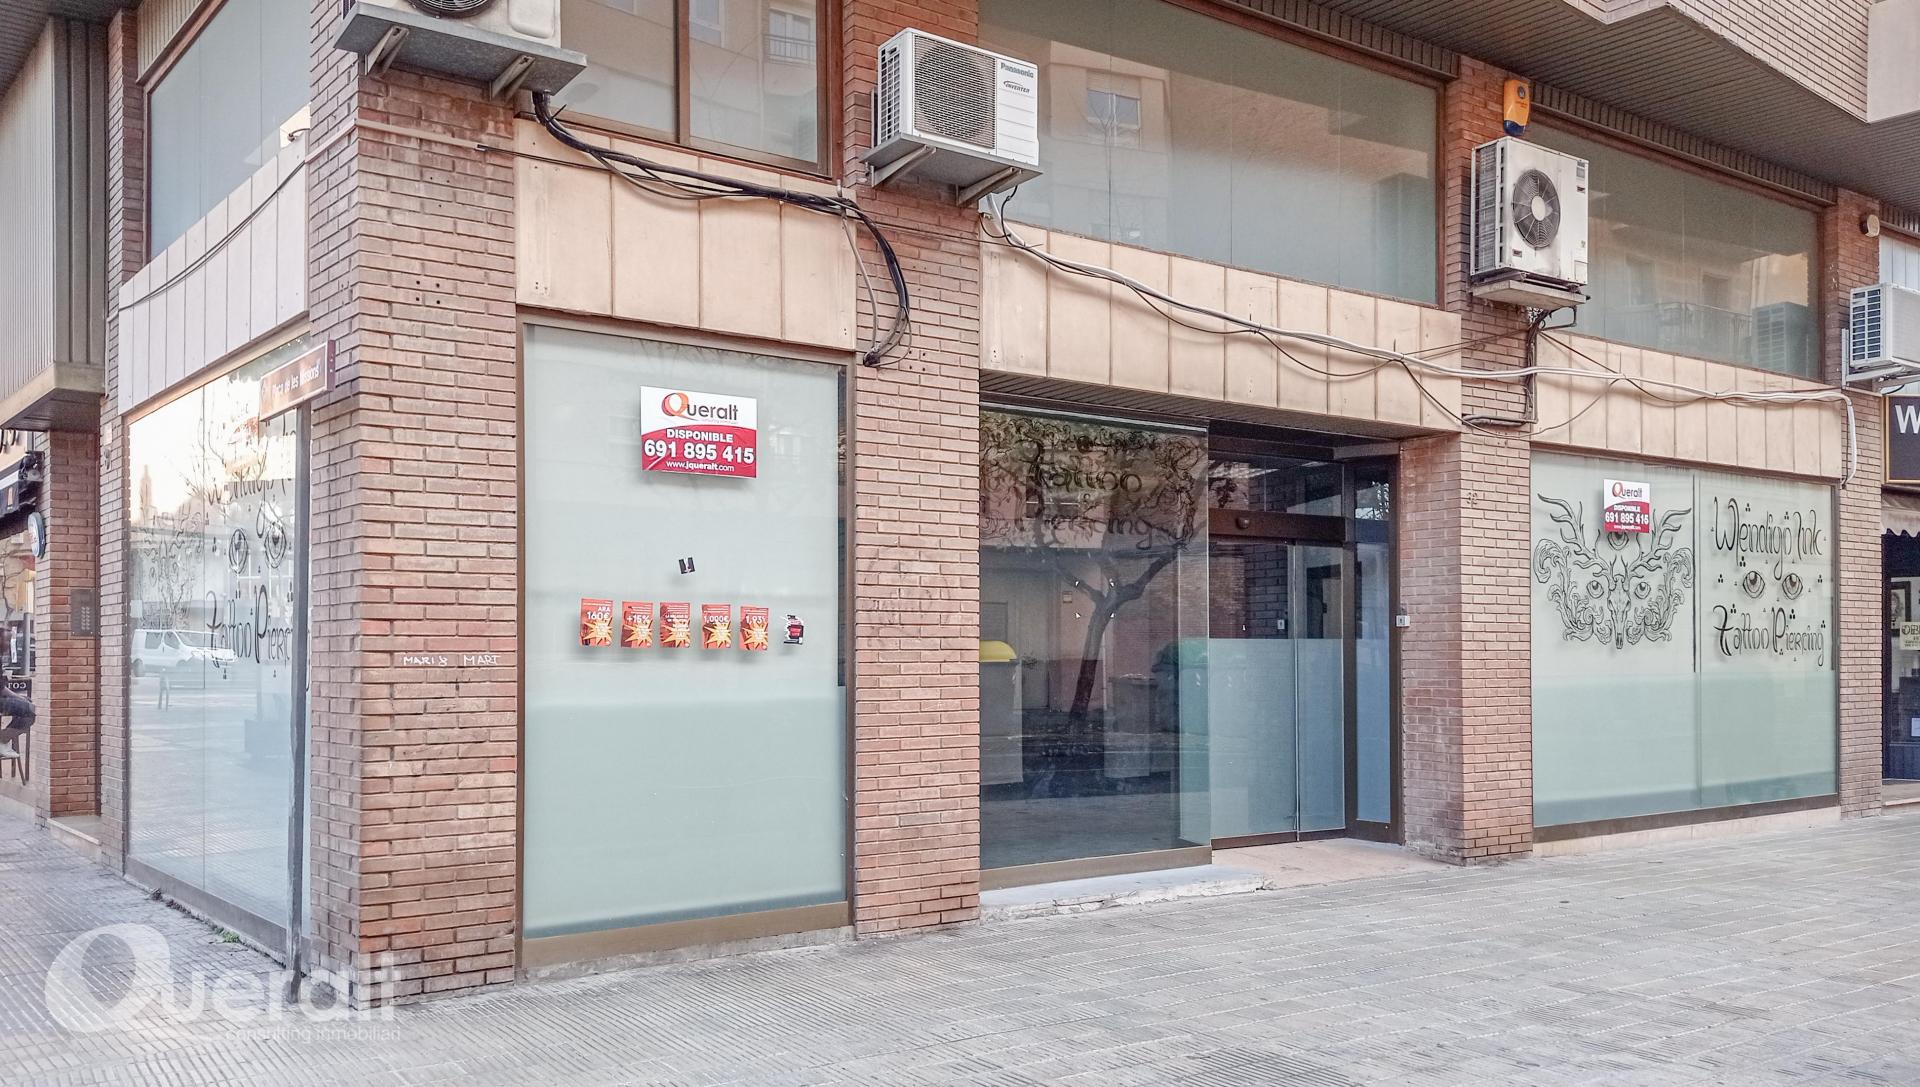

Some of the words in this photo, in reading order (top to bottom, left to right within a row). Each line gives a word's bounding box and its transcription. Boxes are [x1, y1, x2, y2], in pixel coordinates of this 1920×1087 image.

[1000, 62, 1034, 78] Panasonic
[661, 392, 738, 421] Queralt
[666, 428, 734, 443] DISPONIBLE
[644, 439, 677, 458] 691
[683, 442, 717, 461] 895
[722, 445, 755, 464] 415
[665, 460, 735, 472] www.jqueralt.com
[1605, 511, 1619, 523] 691
[1620, 512, 1635, 524] 895
[1635, 513, 1649, 525] 415
[1714, 496, 1792, 580] Wendigo
[1712, 604, 1770, 656] Tattoo
[1771, 607, 1825, 667] Piercing
[1901, 624, 1920, 636] OB
